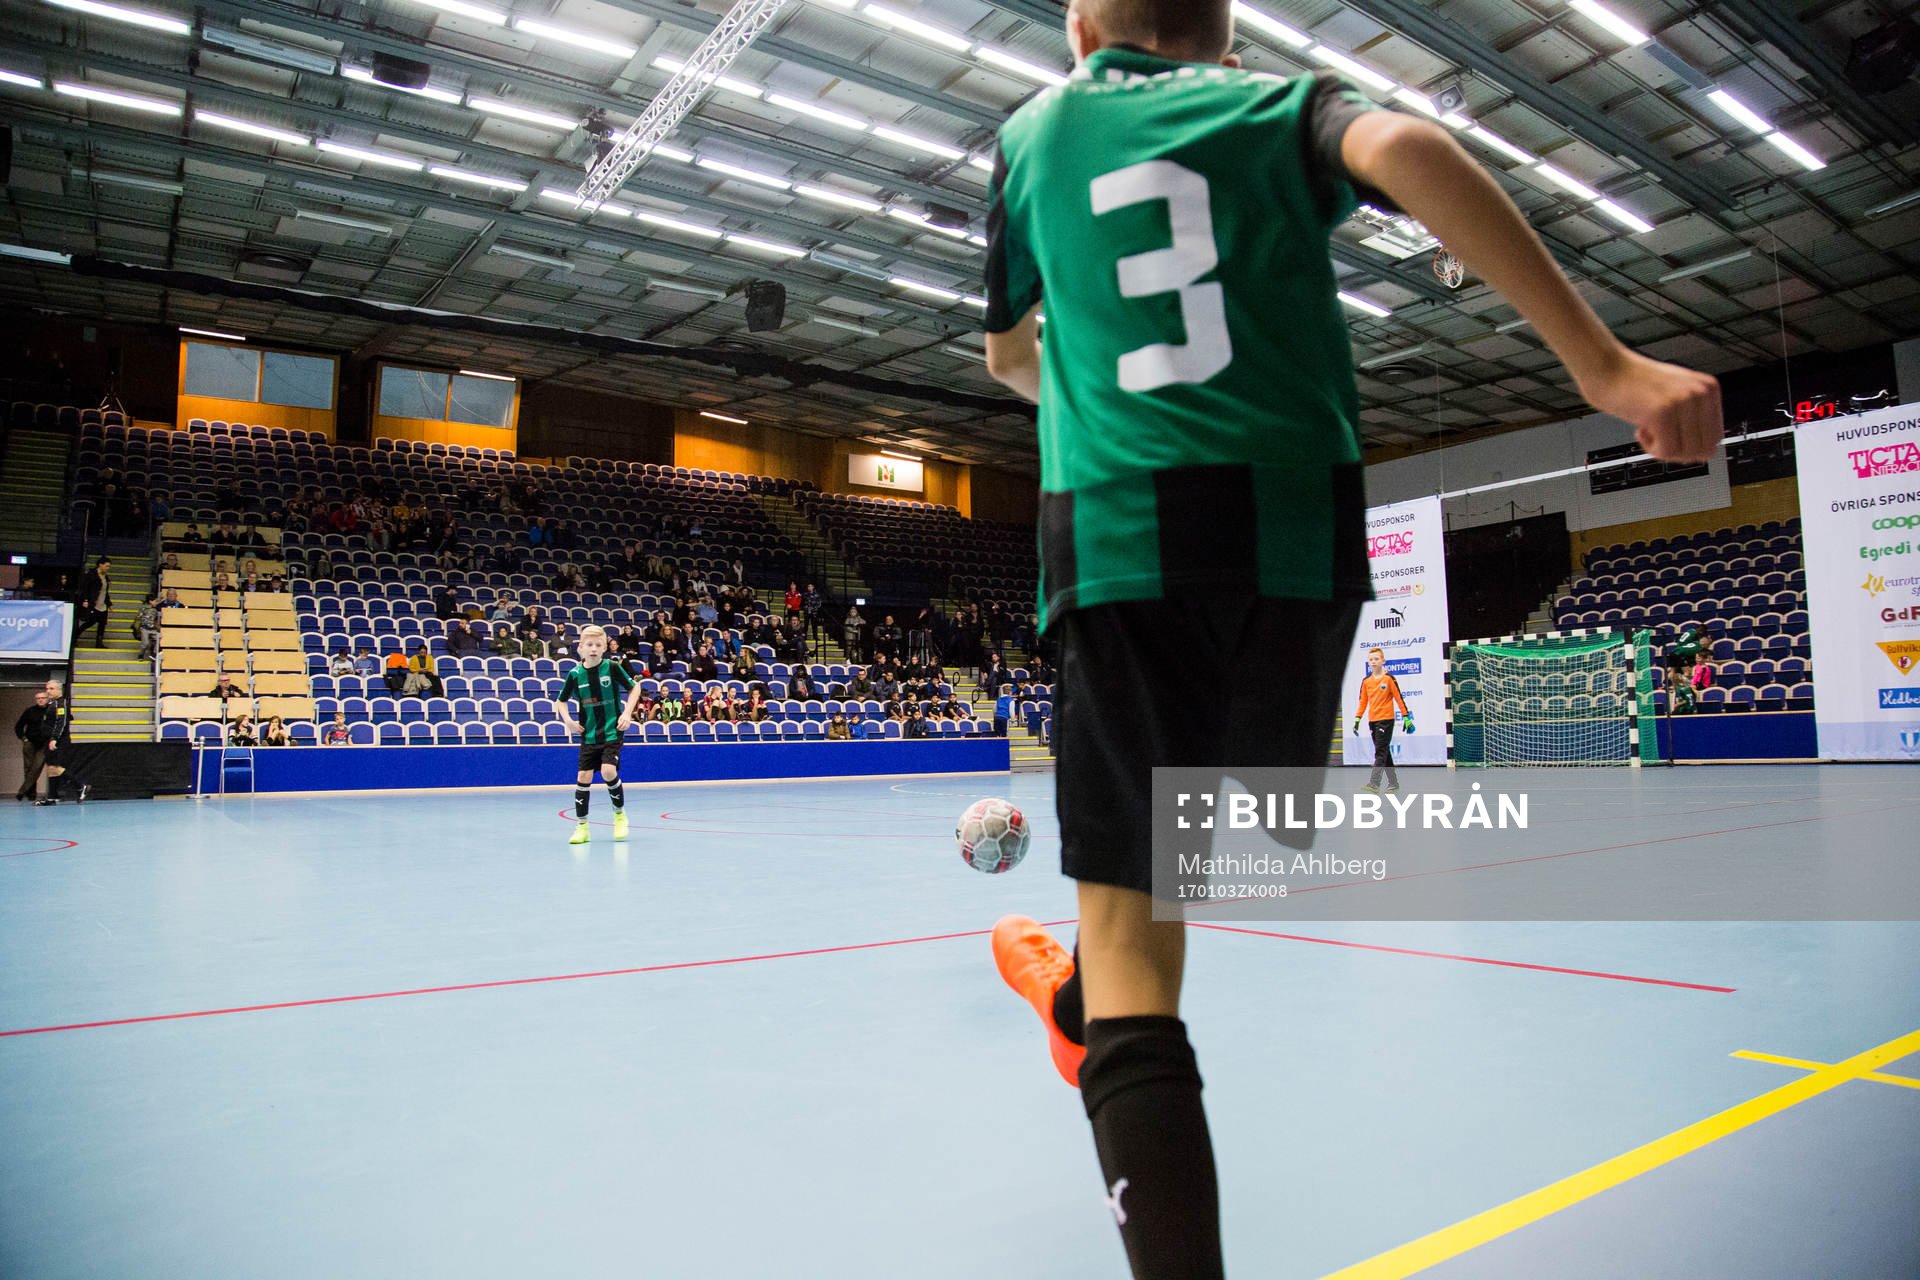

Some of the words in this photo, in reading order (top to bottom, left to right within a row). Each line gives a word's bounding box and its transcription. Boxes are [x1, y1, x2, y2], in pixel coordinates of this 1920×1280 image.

[1089, 159, 1233, 393] 3
[1831, 498, 1876, 512] ÖVRIGA
[1871, 514, 1920, 531] coop
[1860, 541, 1911, 561] Egredi
[1380, 565, 1425, 579] SPONSORER
[0, 617, 49, 631] cupen
[1374, 617, 1401, 630] PUMA
